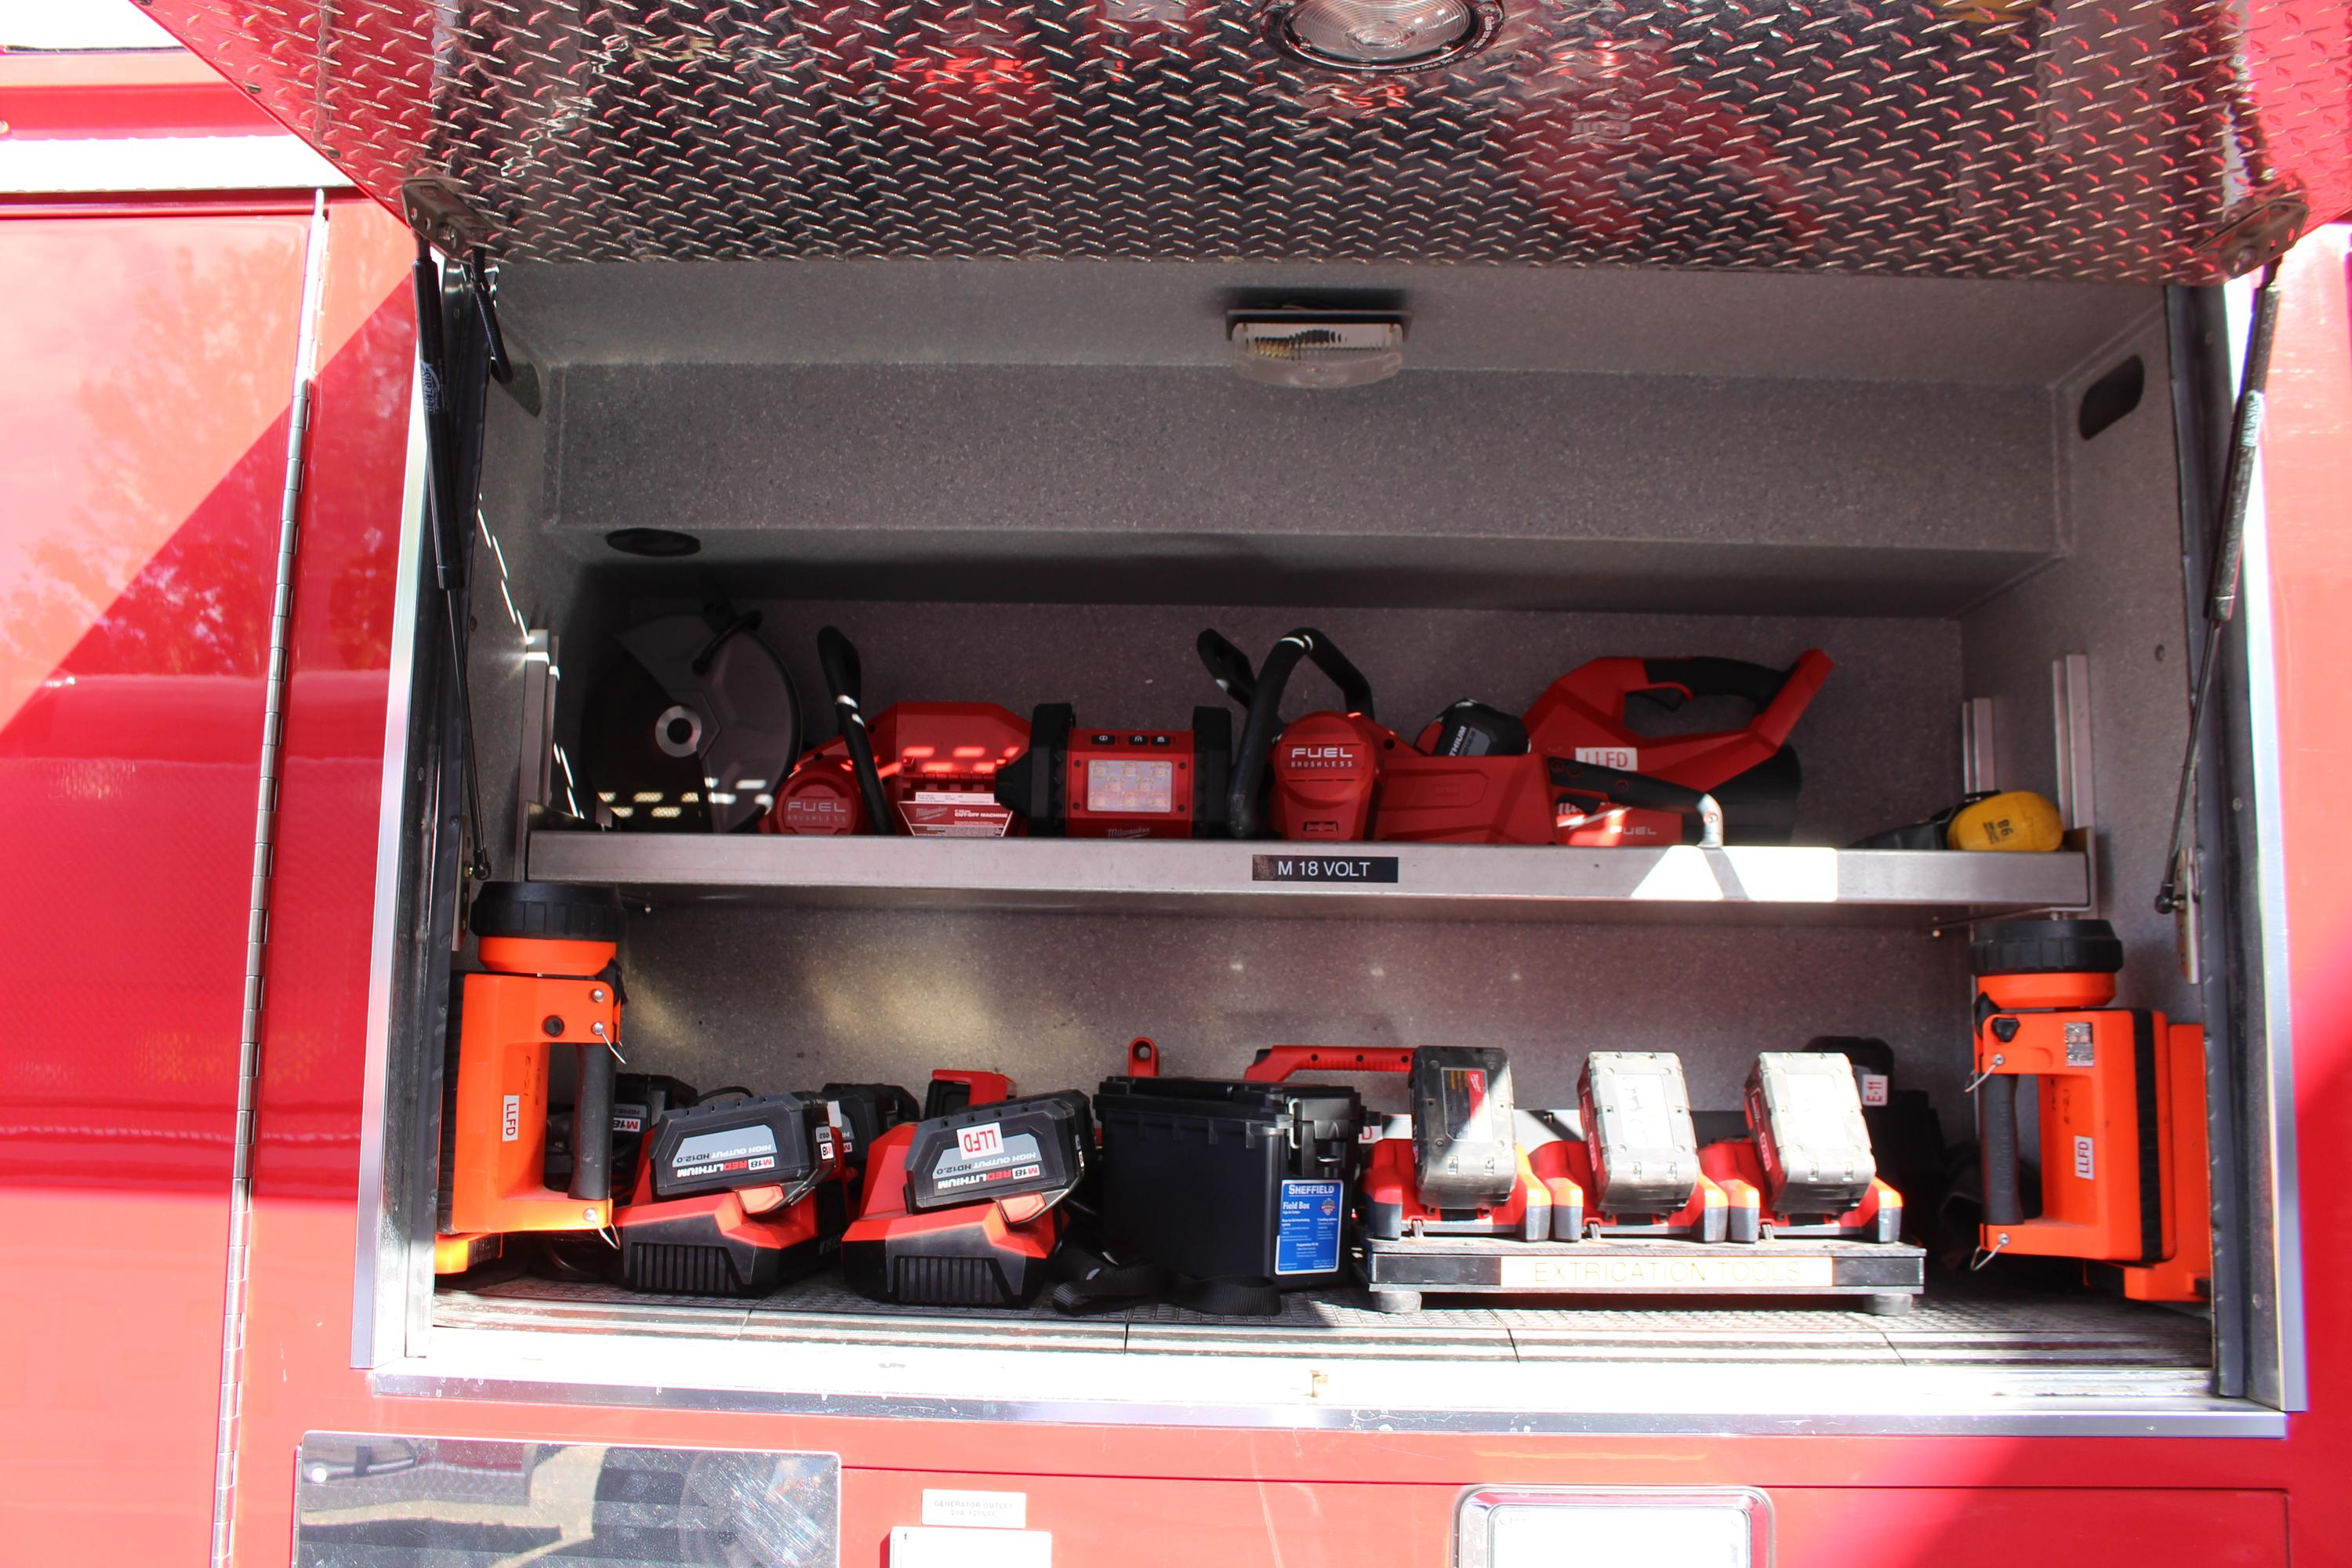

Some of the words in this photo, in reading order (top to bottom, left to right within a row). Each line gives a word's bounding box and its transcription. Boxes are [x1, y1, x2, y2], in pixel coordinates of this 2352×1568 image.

[1291, 747, 1353, 758] FUEL
[788, 802, 846, 812] FUEL
[1277, 861, 1293, 876] M
[1299, 861, 1319, 877] 18
[1323, 862, 1371, 877] VOLT
[506, 1103, 517, 1136] LLFD
[964, 1129, 997, 1152] LLFD
[711, 1148, 747, 1159] OUTPUT
[748, 1144, 772, 1153] HIGH
[751, 1158, 773, 1168] M18
[973, 1156, 1011, 1169] OUTPUT
[1011, 1152, 1036, 1163] HIGH
[2078, 1142, 2090, 1174] LLFD
[1014, 1167, 1038, 1177] M18
[1288, 1185, 1335, 1195] SHEFFIELD
[1283, 1201, 1298, 1210] Field
[1298, 1201, 1310, 1210] Box
[1534, 1261, 1706, 1282] EXTRICATION
[1716, 1261, 1802, 1282] TOOLS
[934, 1500, 981, 1508] GENERATOR
